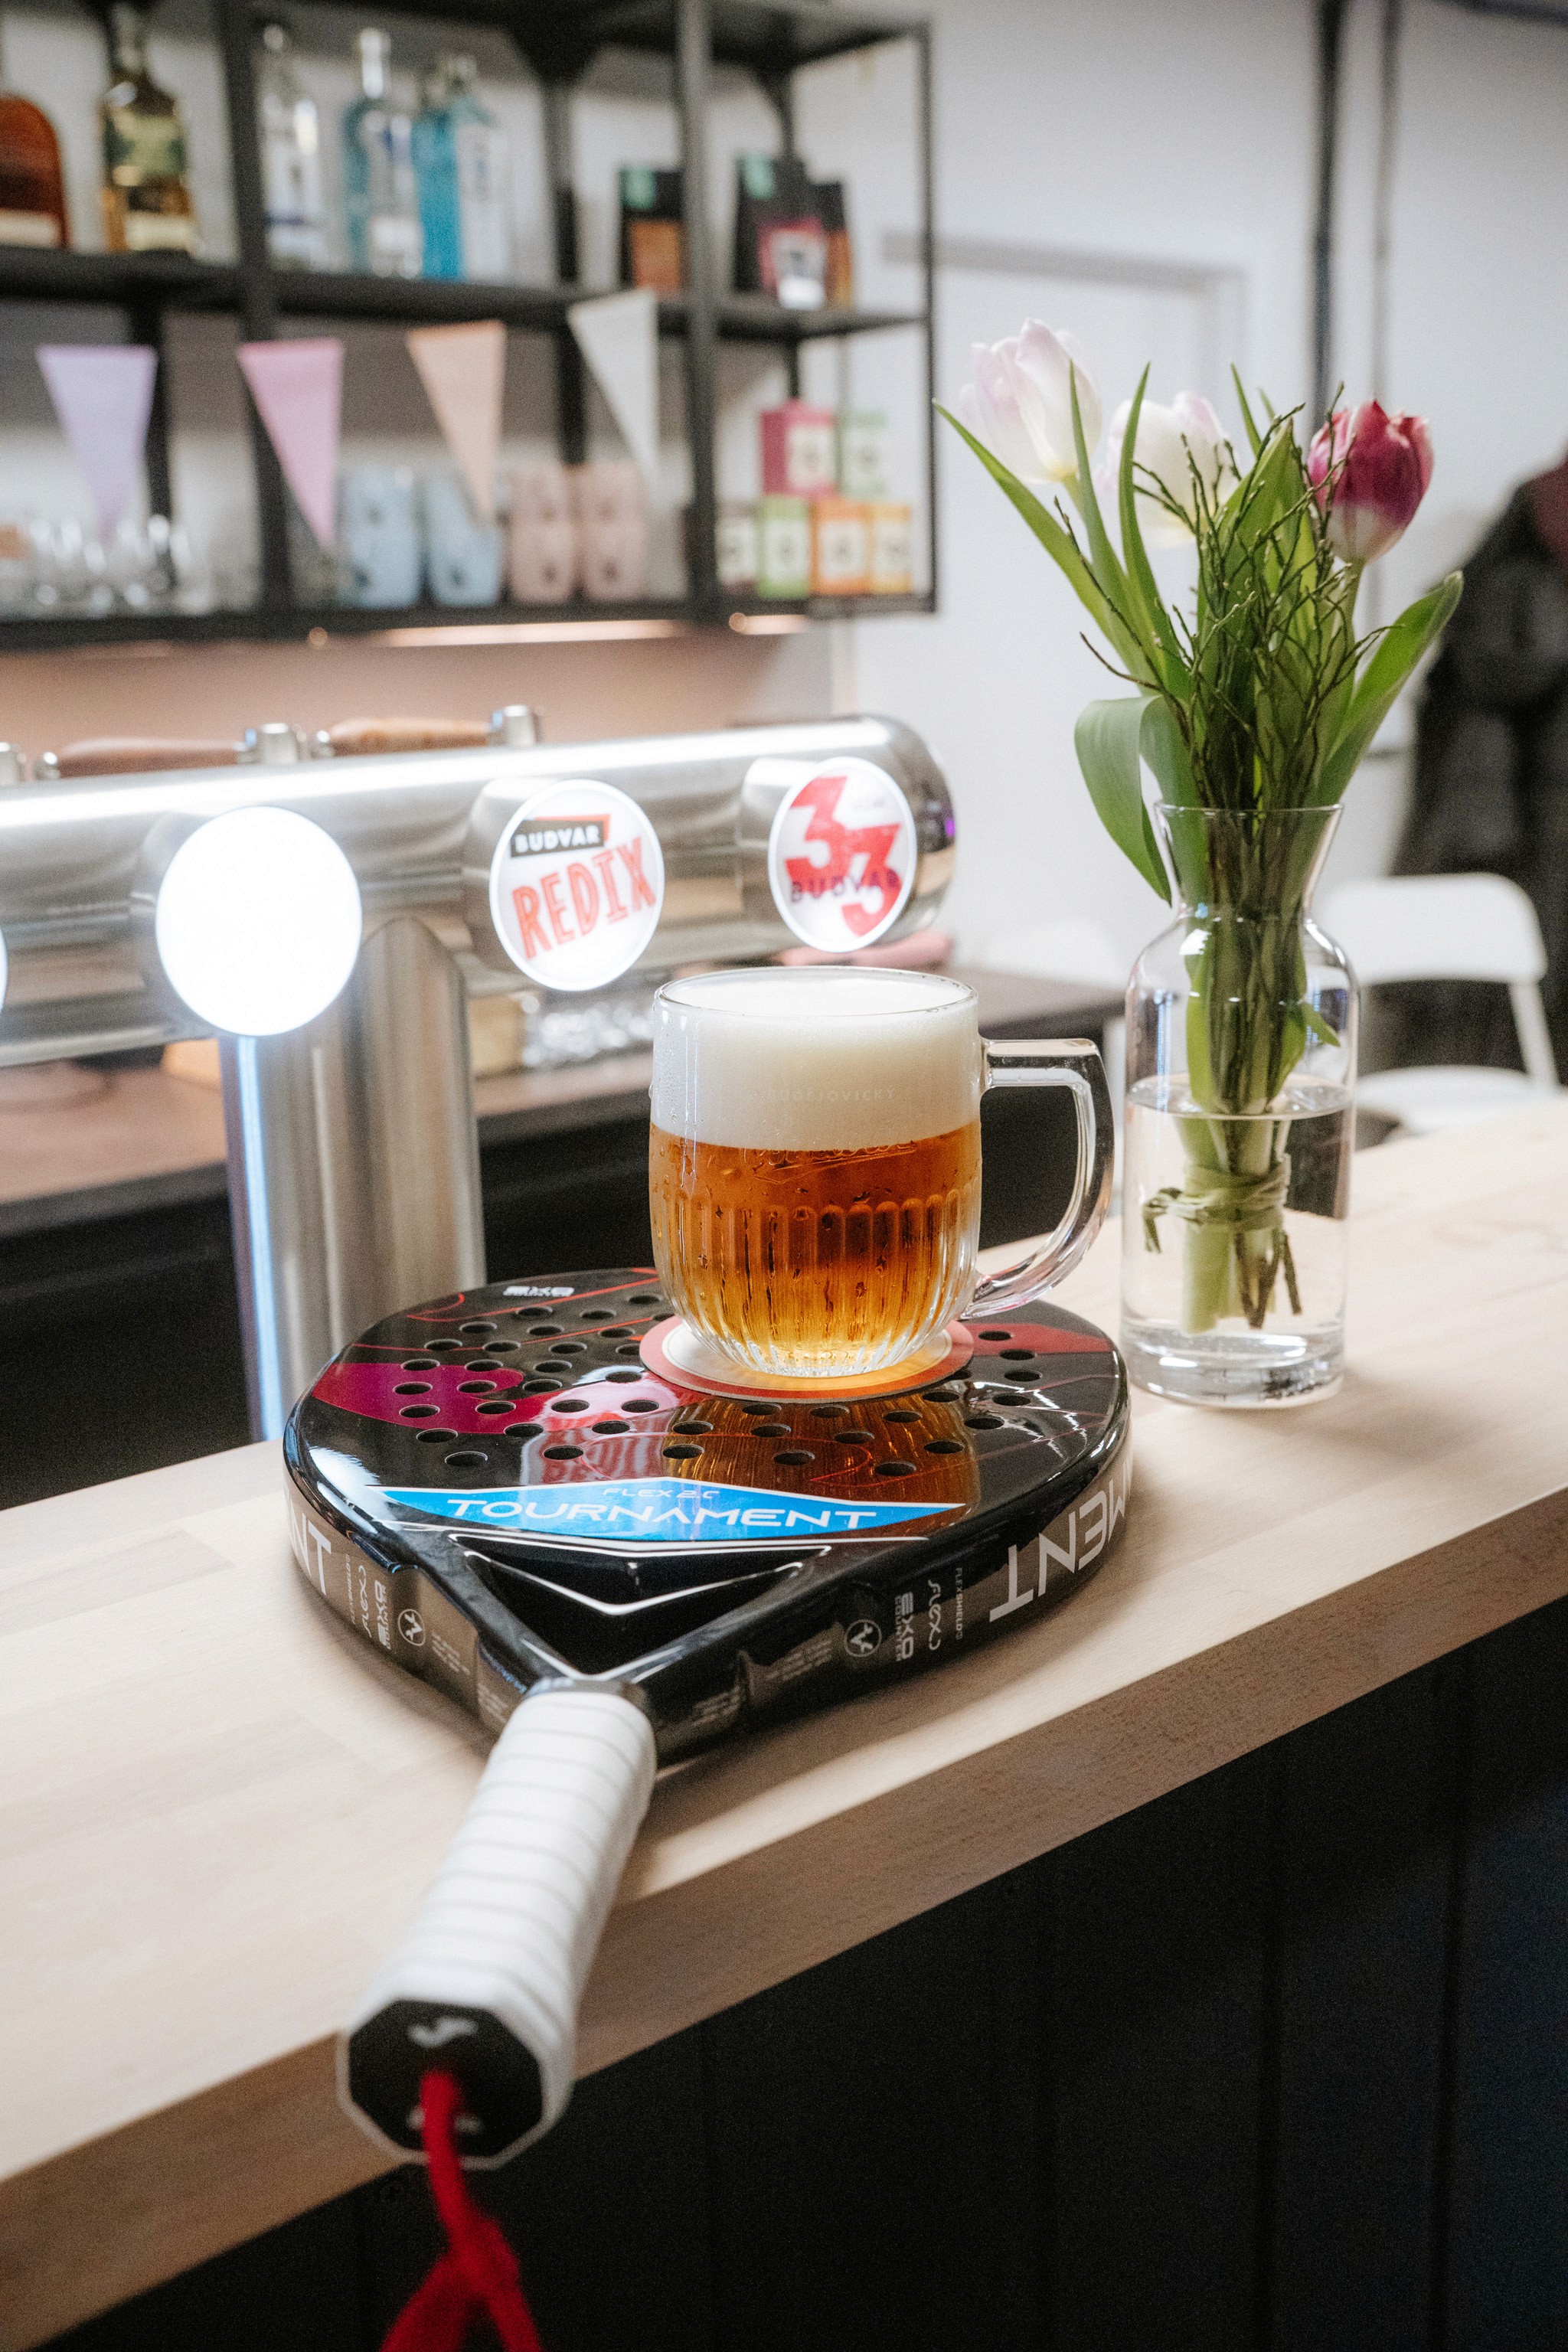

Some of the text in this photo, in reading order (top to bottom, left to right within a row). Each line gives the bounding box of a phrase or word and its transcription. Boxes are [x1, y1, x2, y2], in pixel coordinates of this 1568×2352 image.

[515, 824, 600, 854] BUDVAR
[511, 837, 657, 960] REDIX
[603, 1487, 672, 1498] FLEX
[446, 1499, 877, 1529] TOURNAMENT
